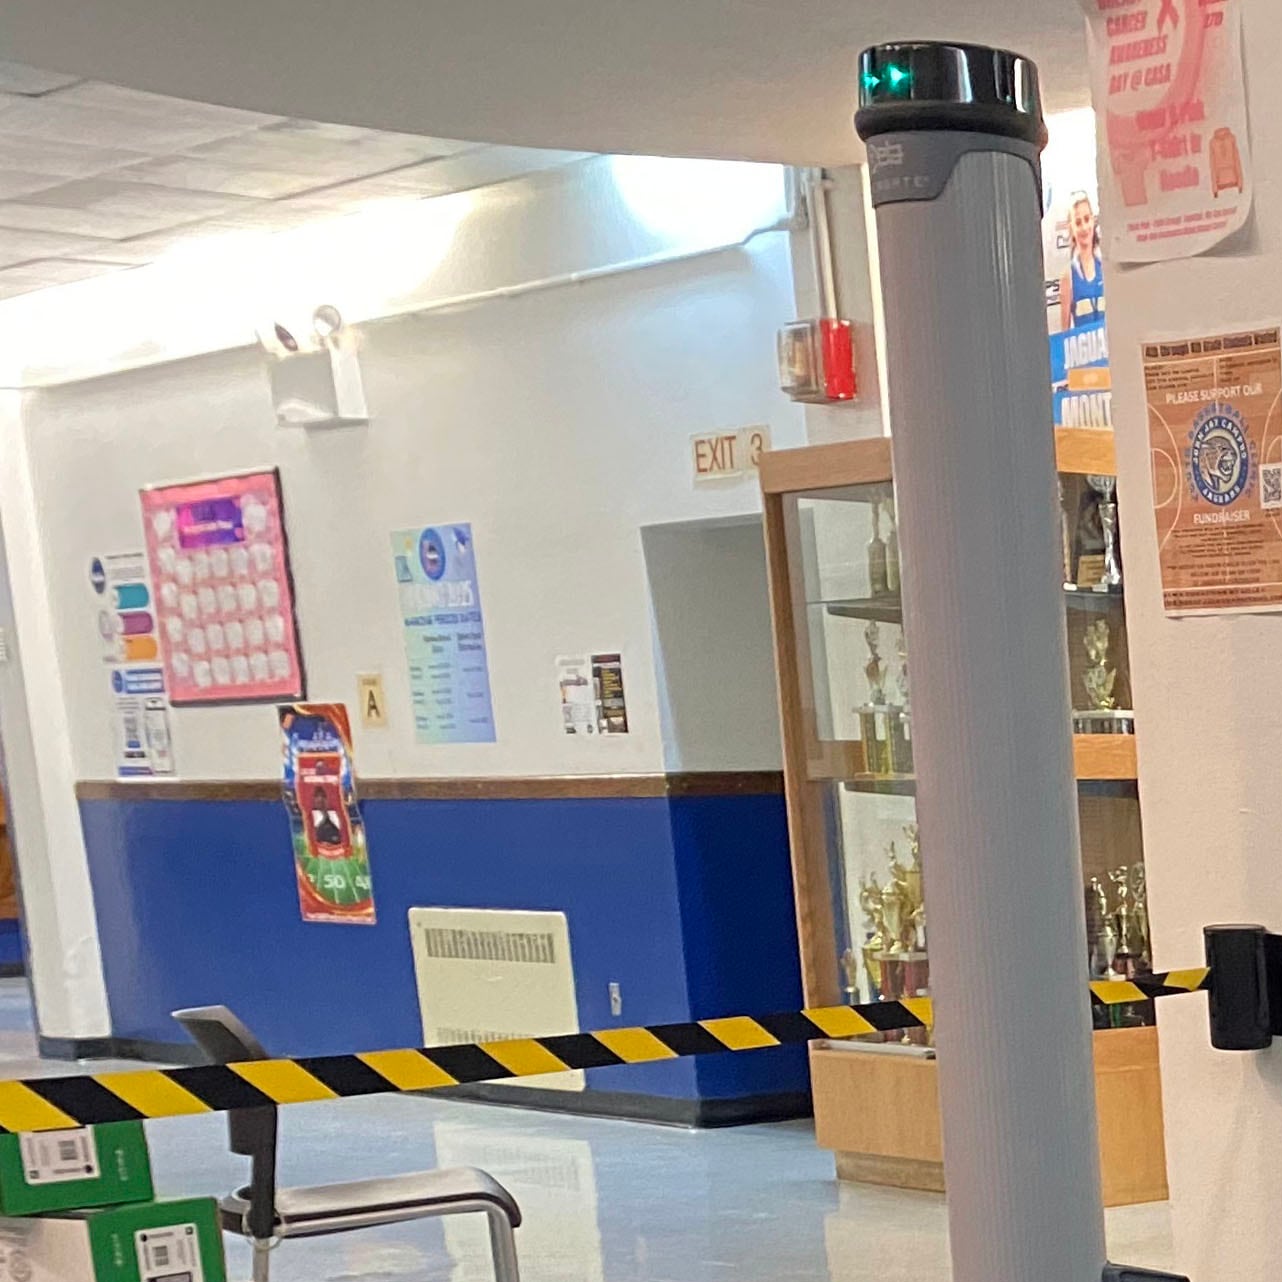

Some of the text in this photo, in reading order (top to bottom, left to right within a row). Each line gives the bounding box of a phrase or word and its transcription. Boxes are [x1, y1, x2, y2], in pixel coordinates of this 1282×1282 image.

[1166, 383, 1264, 405] PLEASE SUPPORT OUR
[695, 433, 763, 473] EXIT 3
[1193, 510, 1251, 525] FUNDRAISER
[366, 690, 381, 718] A
[323, 873, 346, 890] 50
